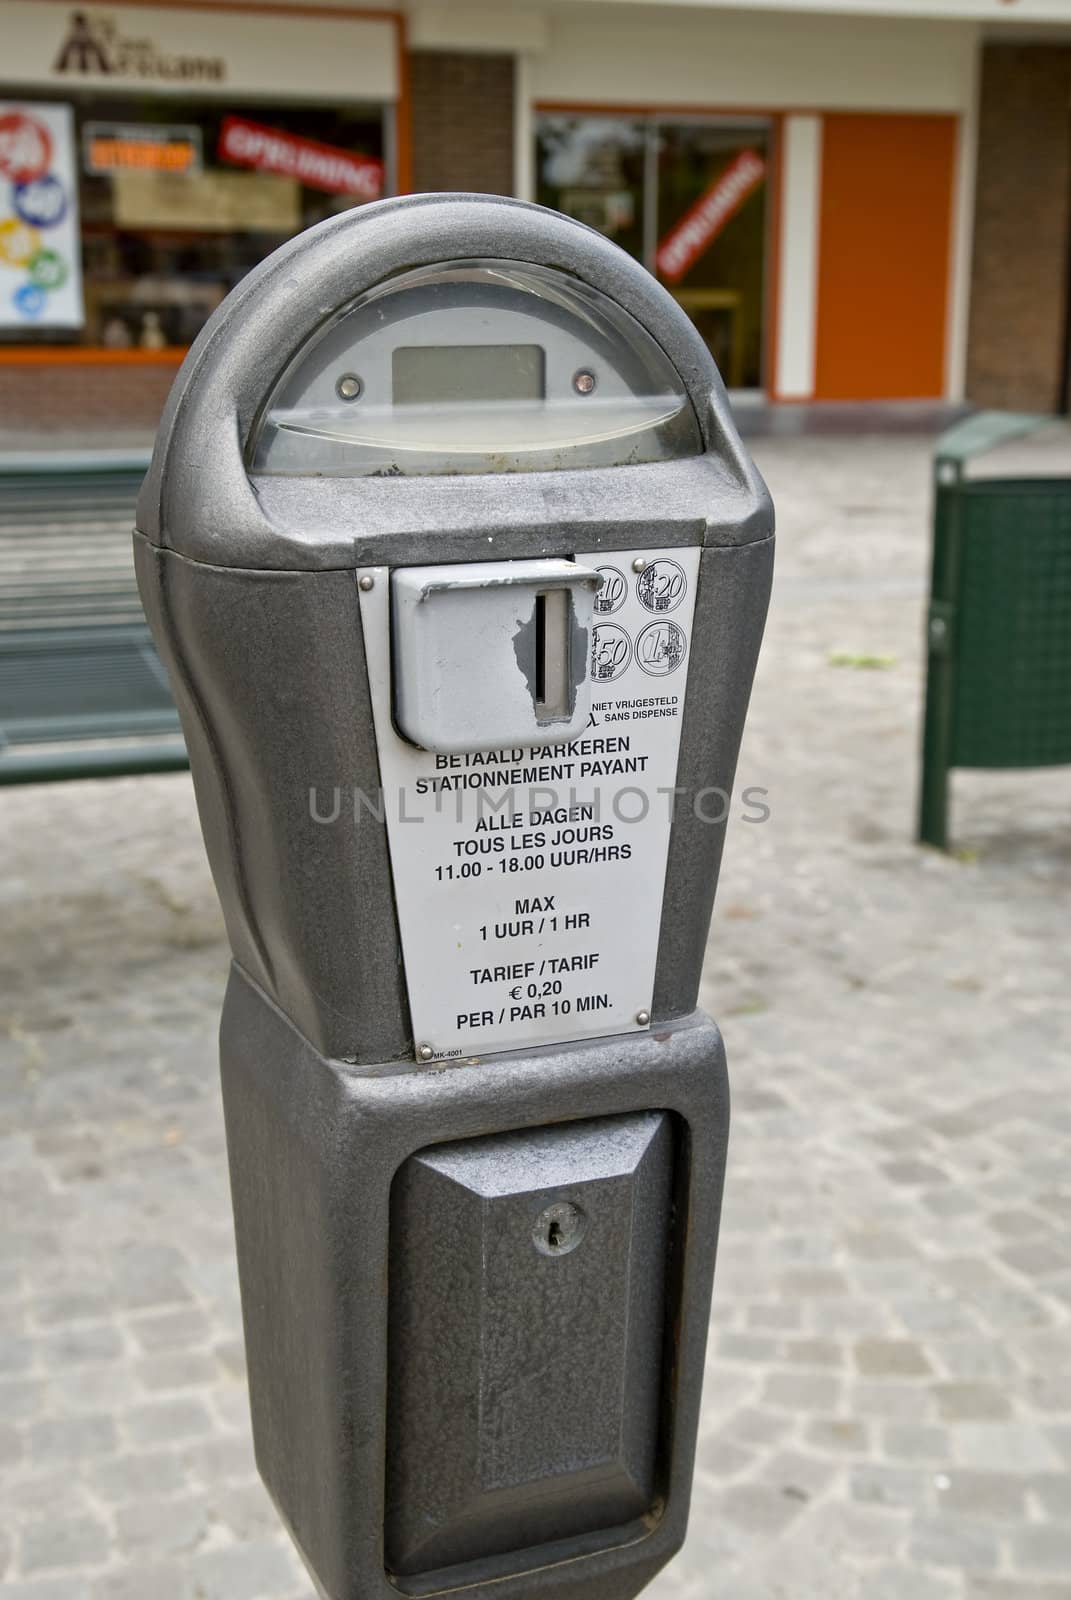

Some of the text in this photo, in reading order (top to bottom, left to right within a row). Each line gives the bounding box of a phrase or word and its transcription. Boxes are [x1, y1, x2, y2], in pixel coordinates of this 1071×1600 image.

[657, 575, 683, 599] 20
[597, 638, 628, 667] 50
[592, 696, 678, 712] NIET VRIJGESTELD
[604, 711, 630, 722] SANS
[632, 707, 678, 720] DISPENSE
[435, 735, 630, 770] BETAALD PARKEREN
[415, 756, 649, 794] STATIONNEMENT PAYANT
[474, 806, 593, 833] ALLE DAGEN
[453, 824, 614, 857] TOUS LES JOURS
[435, 861, 482, 881] 11.00
[499, 854, 545, 874] 18.00
[550, 843, 632, 868] UUR/HRS
[515, 895, 555, 915] MAX
[479, 926, 487, 941] 1
[495, 920, 534, 939] UUR
[550, 917, 558, 932] 1
[565, 913, 590, 930] HR
[470, 962, 535, 985] TARIEF
[548, 953, 600, 975] TARIF
[508, 980, 562, 1000] € 0,20
[456, 1010, 494, 1030] PER
[510, 1003, 546, 1022] PAR
[551, 999, 571, 1016] 10
[576, 993, 613, 1012] MIN.
